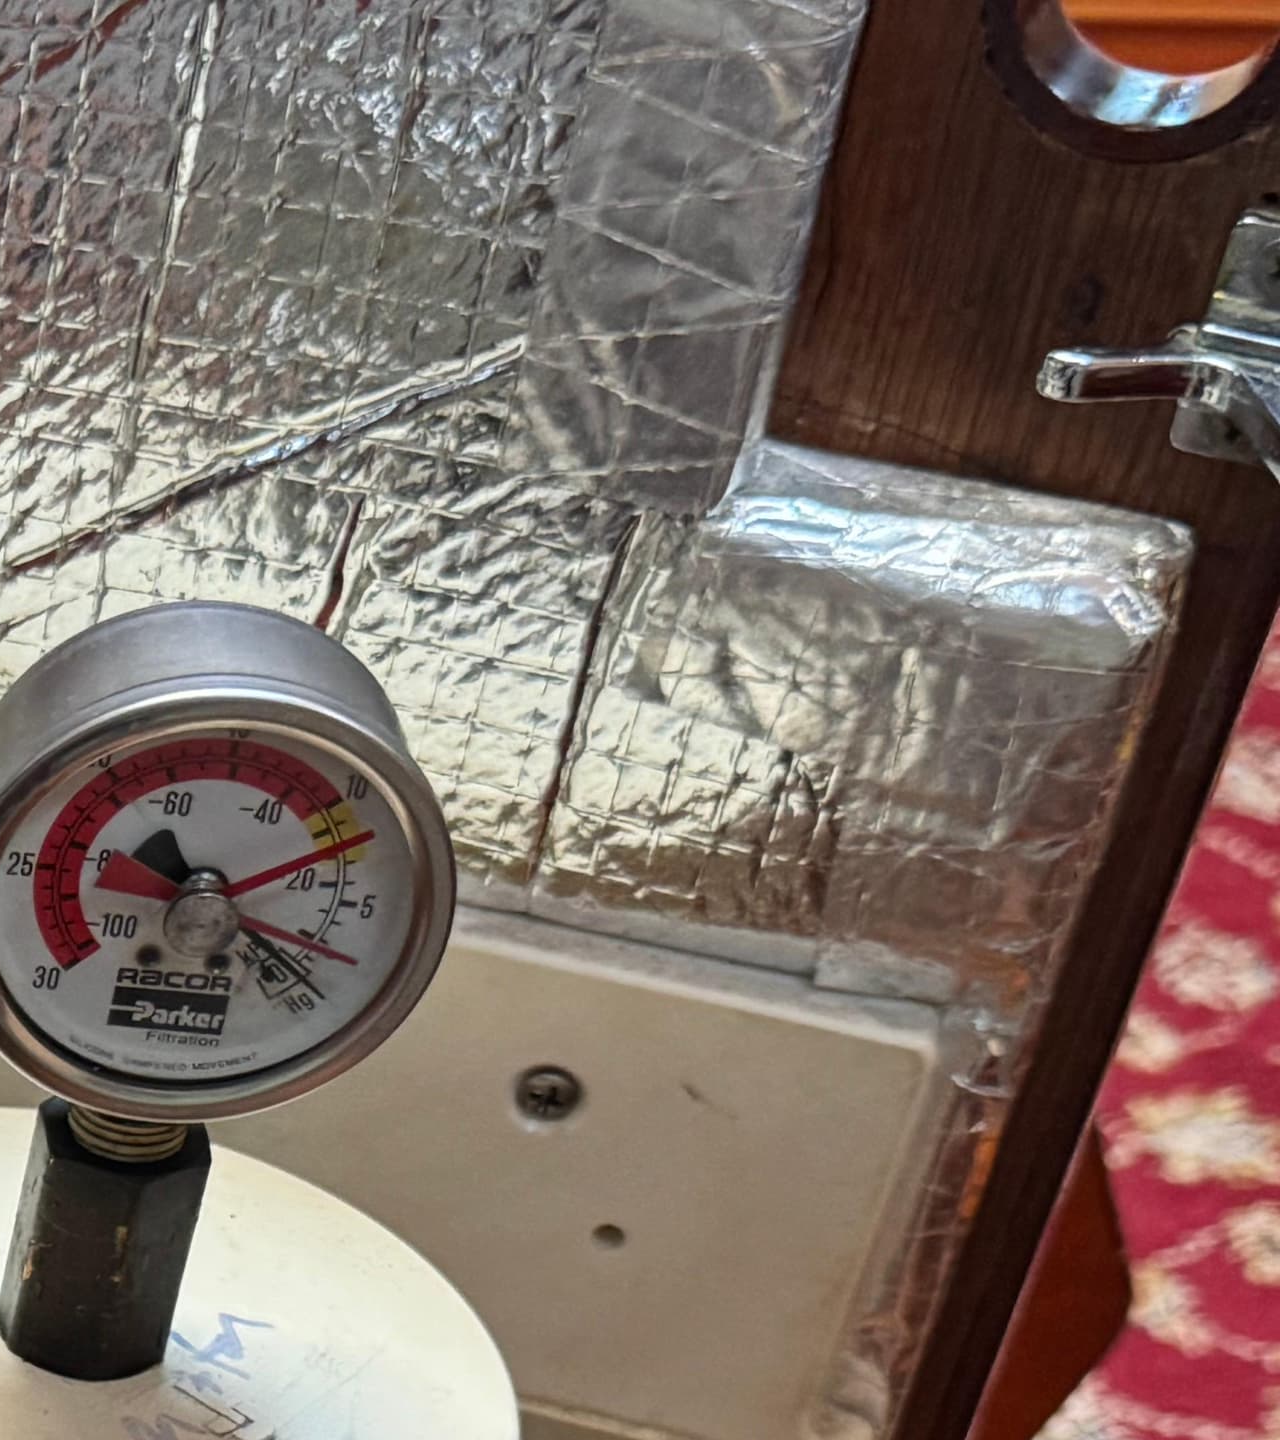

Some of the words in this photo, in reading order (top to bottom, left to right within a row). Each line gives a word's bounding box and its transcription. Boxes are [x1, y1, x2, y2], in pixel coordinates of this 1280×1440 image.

[346, 774, 369, 800] 10
[7, 853, 33, 877] 25
[360, 895, 375, 920] 5
[33, 966, 61, 991] 30
[131, 1000, 225, 1030] Parker
[145, 1031, 220, 1047] Filtration
